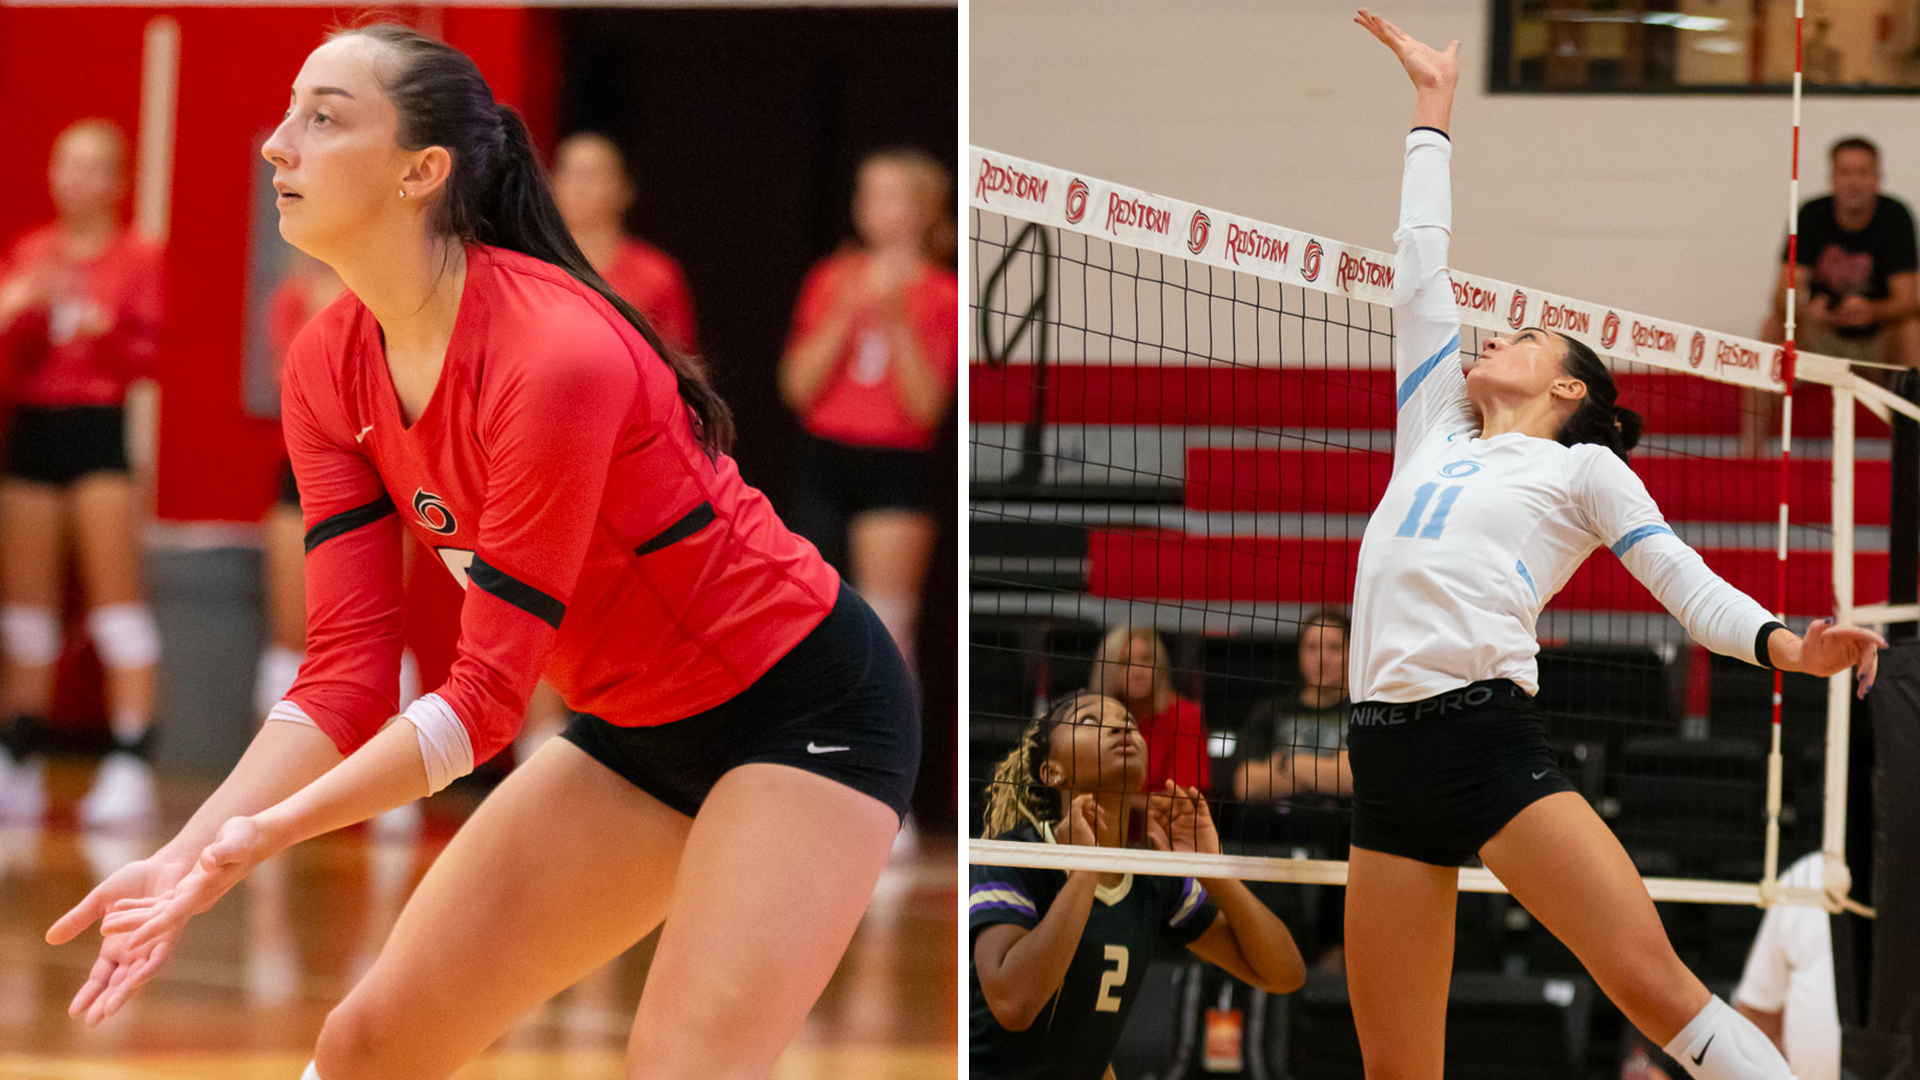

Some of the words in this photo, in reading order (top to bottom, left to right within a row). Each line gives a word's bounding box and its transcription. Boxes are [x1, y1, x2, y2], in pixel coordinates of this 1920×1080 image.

[1448, 276, 1497, 314] DSTORM
[1395, 481, 1466, 540] 11
[1351, 704, 1407, 726] NIKE
[1414, 686, 1493, 721] PRO
[1095, 944, 1129, 1012] 2
